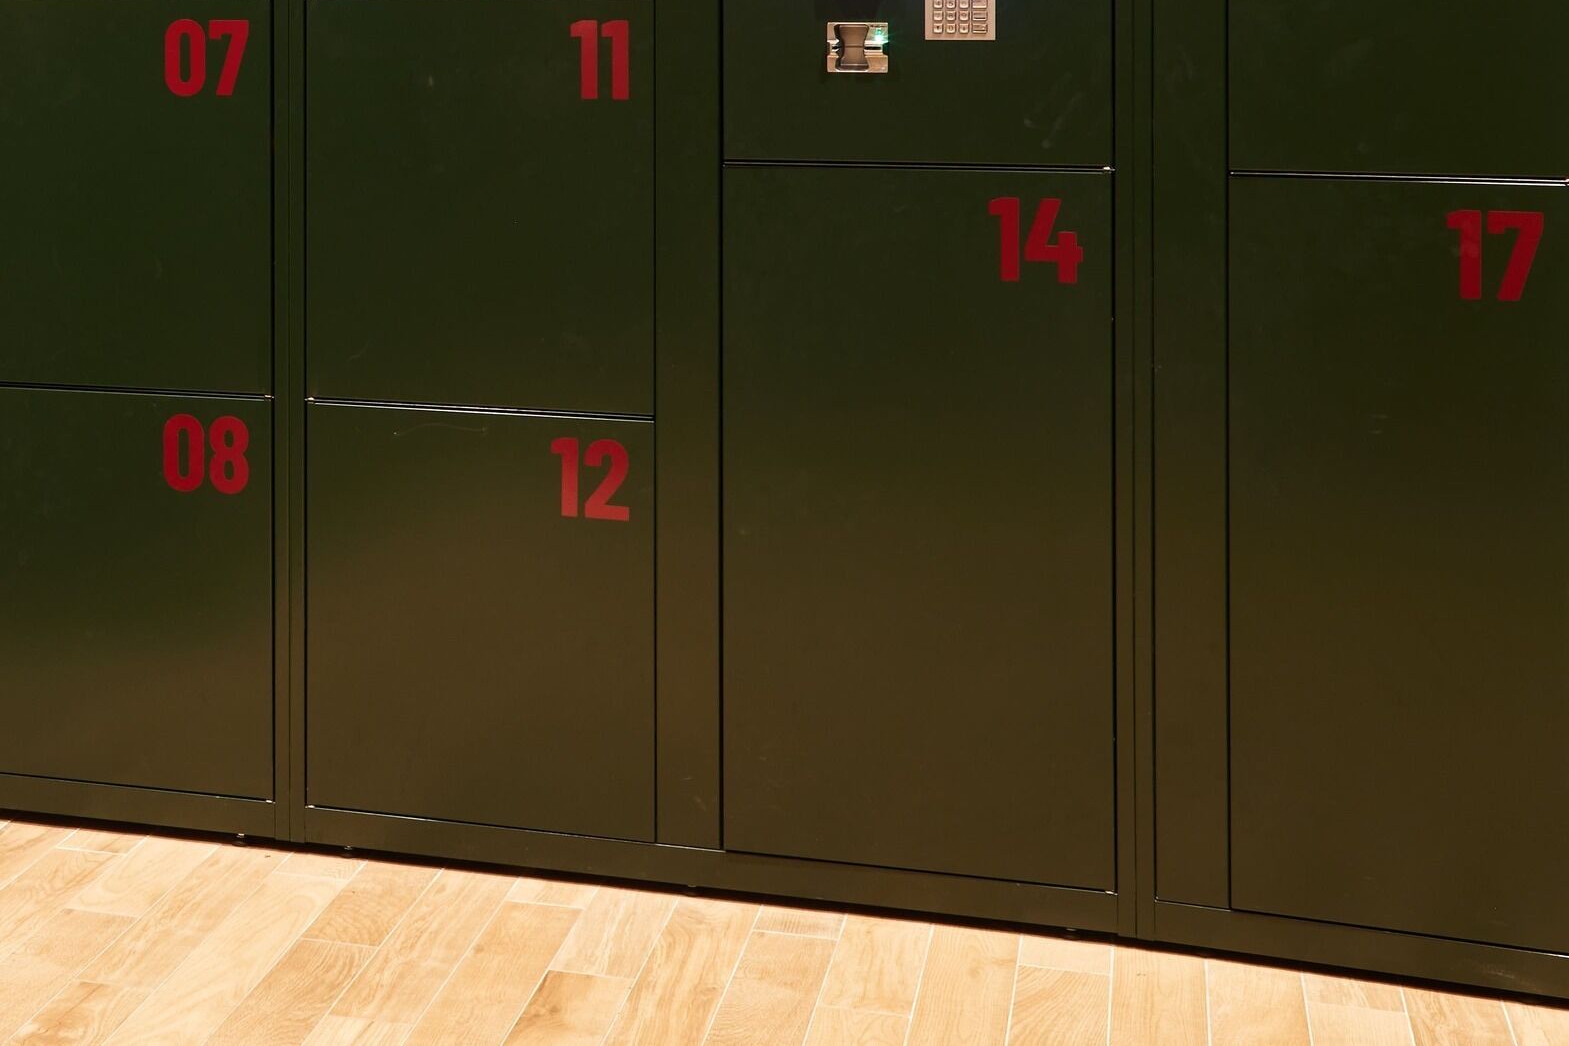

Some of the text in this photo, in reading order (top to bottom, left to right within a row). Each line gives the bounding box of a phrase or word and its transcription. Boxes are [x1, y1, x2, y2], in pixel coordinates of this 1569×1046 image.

[165, 20, 249, 97] 07
[570, 20, 630, 101] 11
[989, 198, 1084, 283] 14
[1447, 210, 1544, 301] 17
[164, 414, 250, 495] 08
[552, 438, 629, 521] 12
